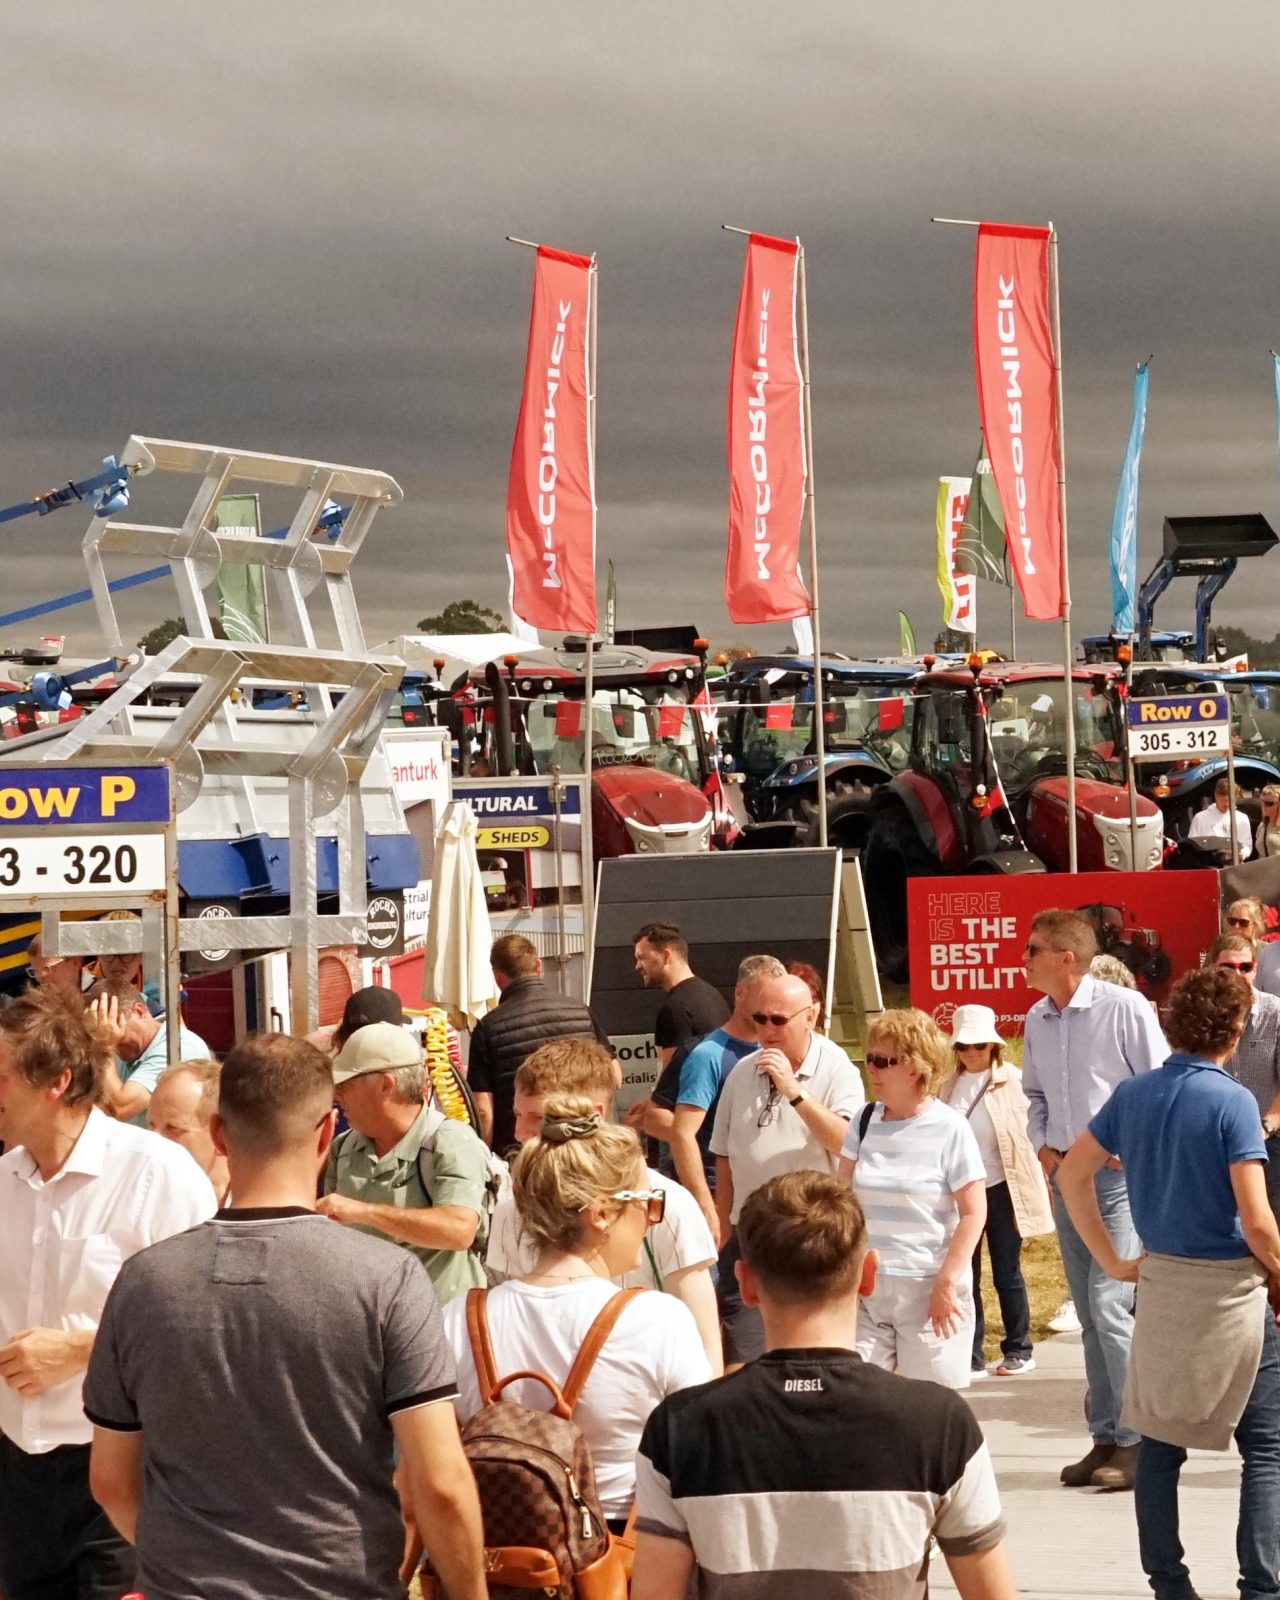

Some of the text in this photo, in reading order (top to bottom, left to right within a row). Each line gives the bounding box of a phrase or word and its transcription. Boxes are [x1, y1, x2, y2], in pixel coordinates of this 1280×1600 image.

[1141, 699, 1217, 721] Row O
[1140, 733, 1170, 751] 305
[1187, 730, 1217, 748] 312
[392, 758, 438, 783] anturk
[0, 776, 136, 819] ow P
[468, 795, 538, 813] LTURAL
[0, 844, 137, 886] 3 - 320
[404, 890, 428, 904] strial
[929, 892, 1001, 916] HERE
[930, 917, 1017, 941] IS THE
[930, 942, 999, 966] BEST
[609, 1041, 658, 1060] och
[621, 1072, 658, 1085] cialis
[785, 1378, 824, 1392] DIESEL
